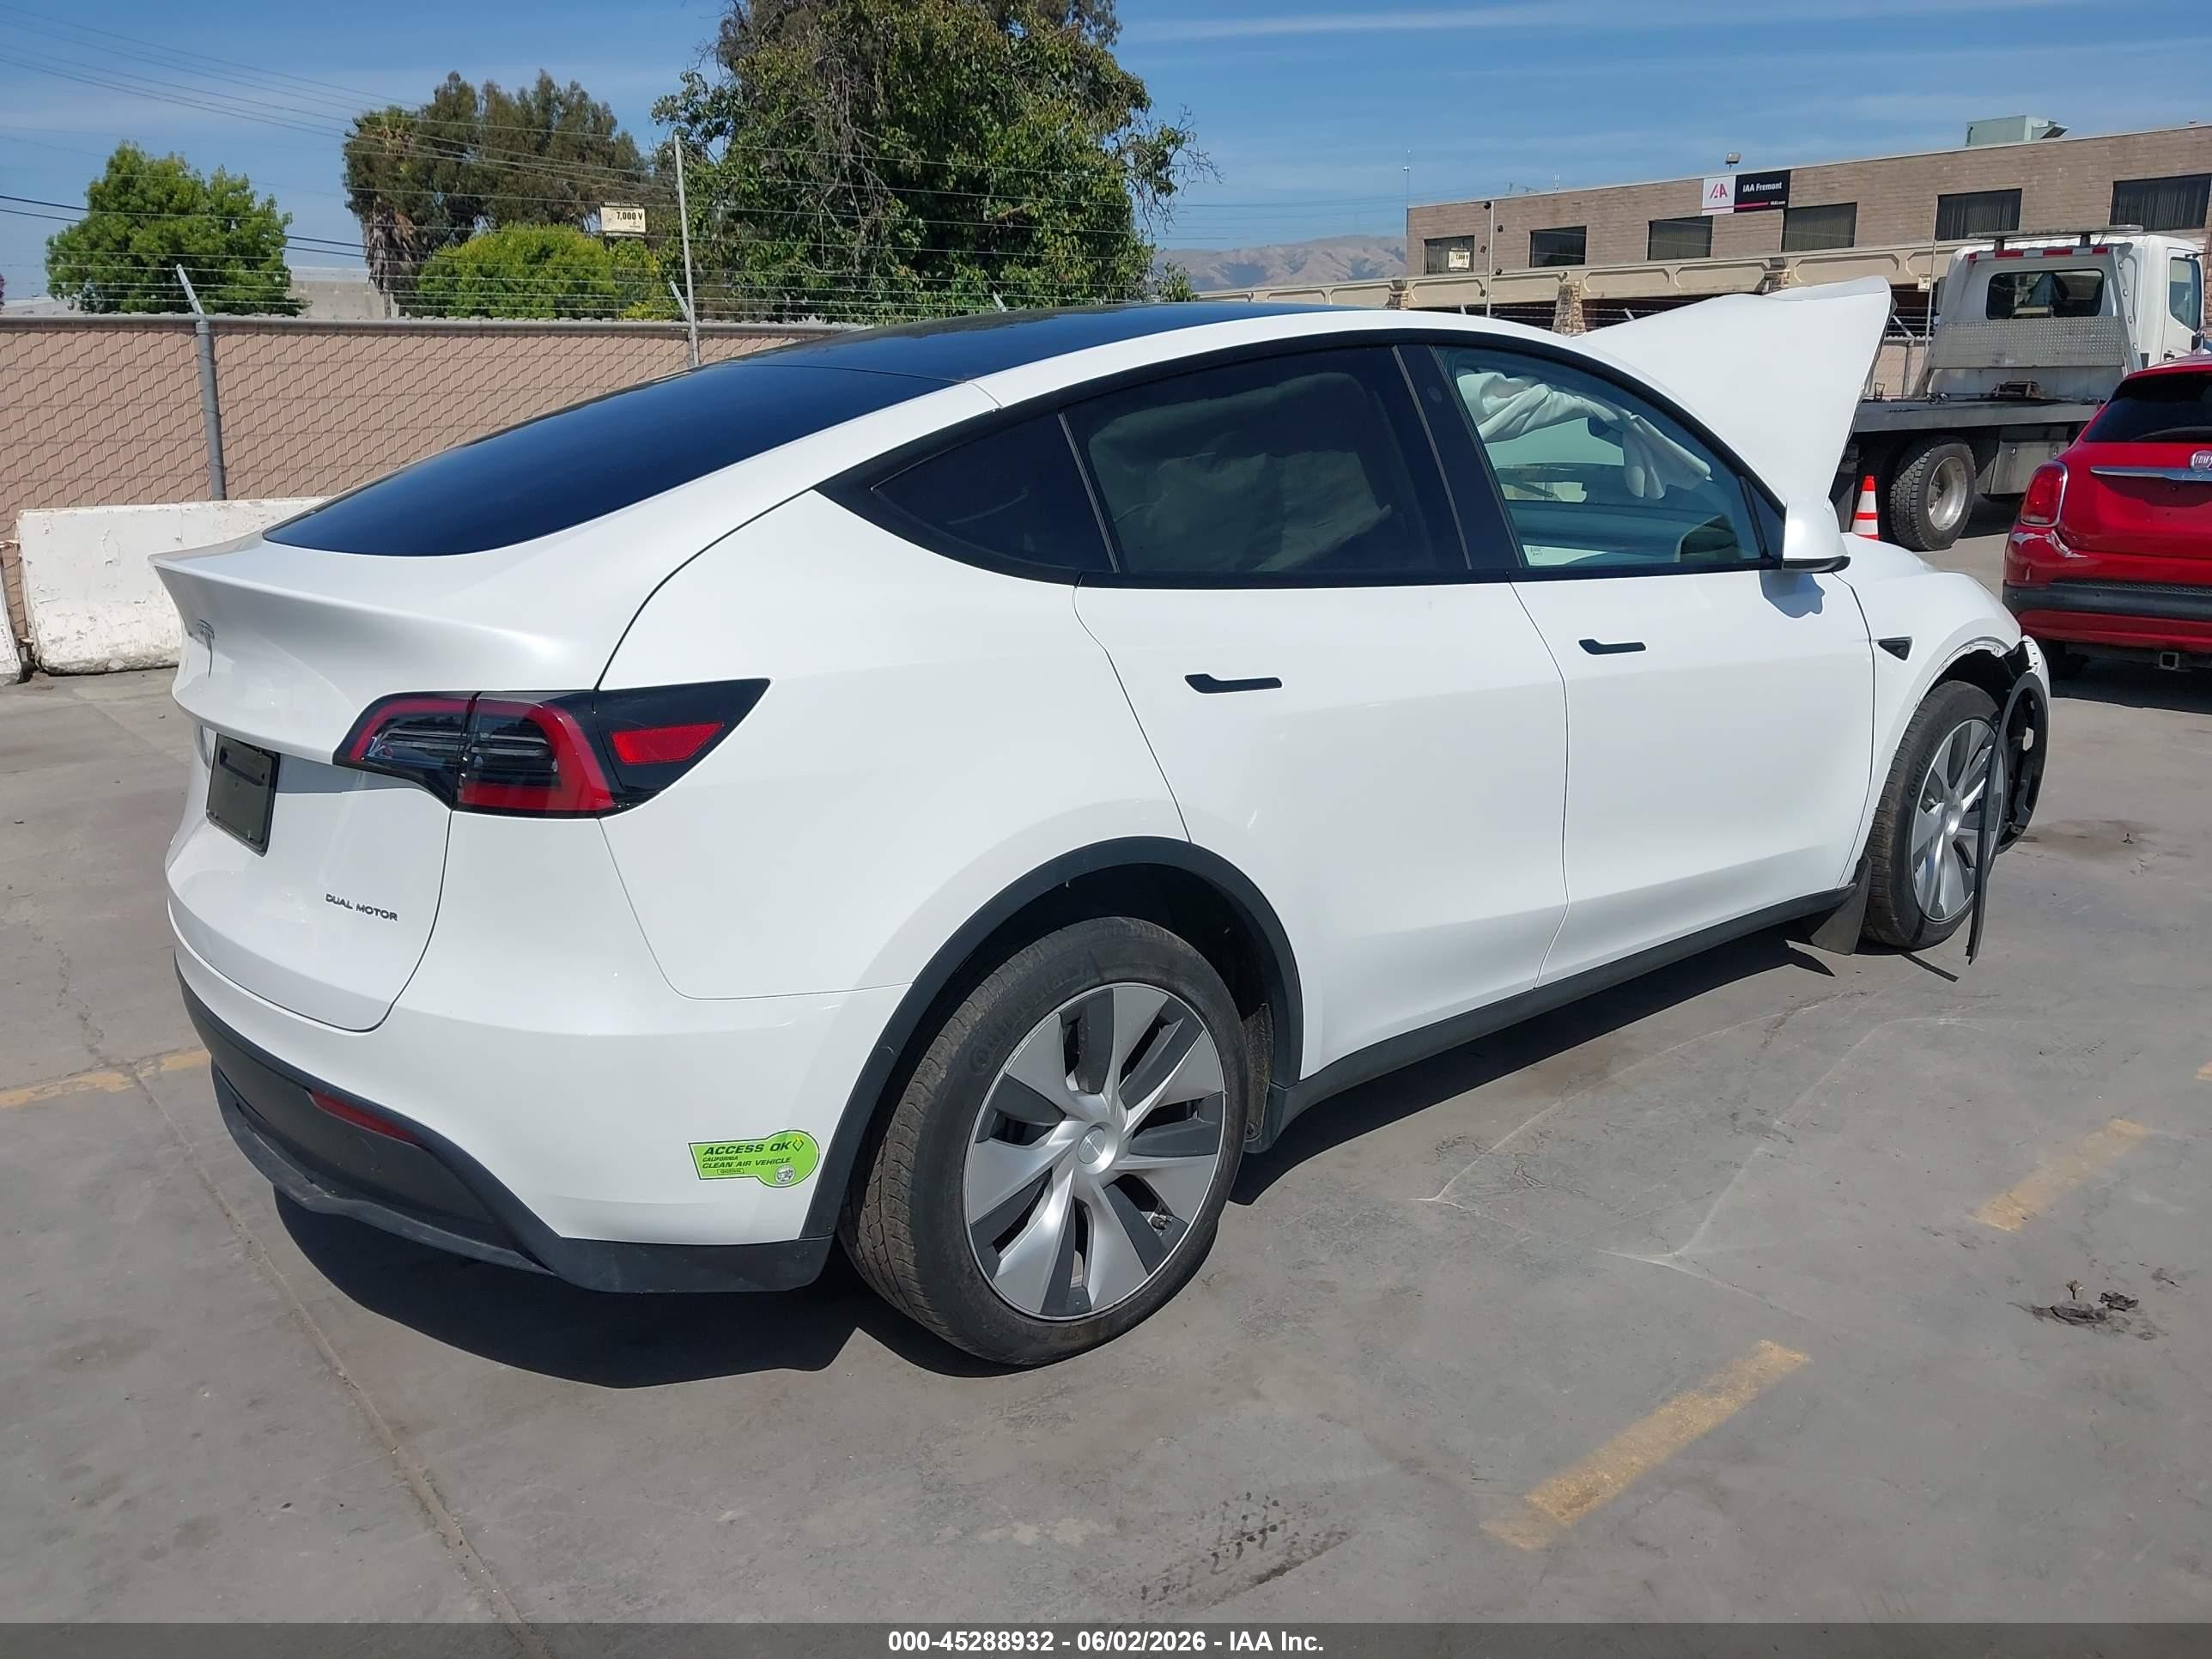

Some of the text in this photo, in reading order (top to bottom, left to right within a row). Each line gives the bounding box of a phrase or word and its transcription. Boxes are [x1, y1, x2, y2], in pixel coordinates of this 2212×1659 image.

[1742, 182, 1782, 193] IAA Fremont
[638, 212, 643, 221] V
[325, 893, 398, 921] DUAL MOTOR
[703, 1140, 792, 1155] ACCESS OK
[755, 1157, 792, 1166] VEHICLE
